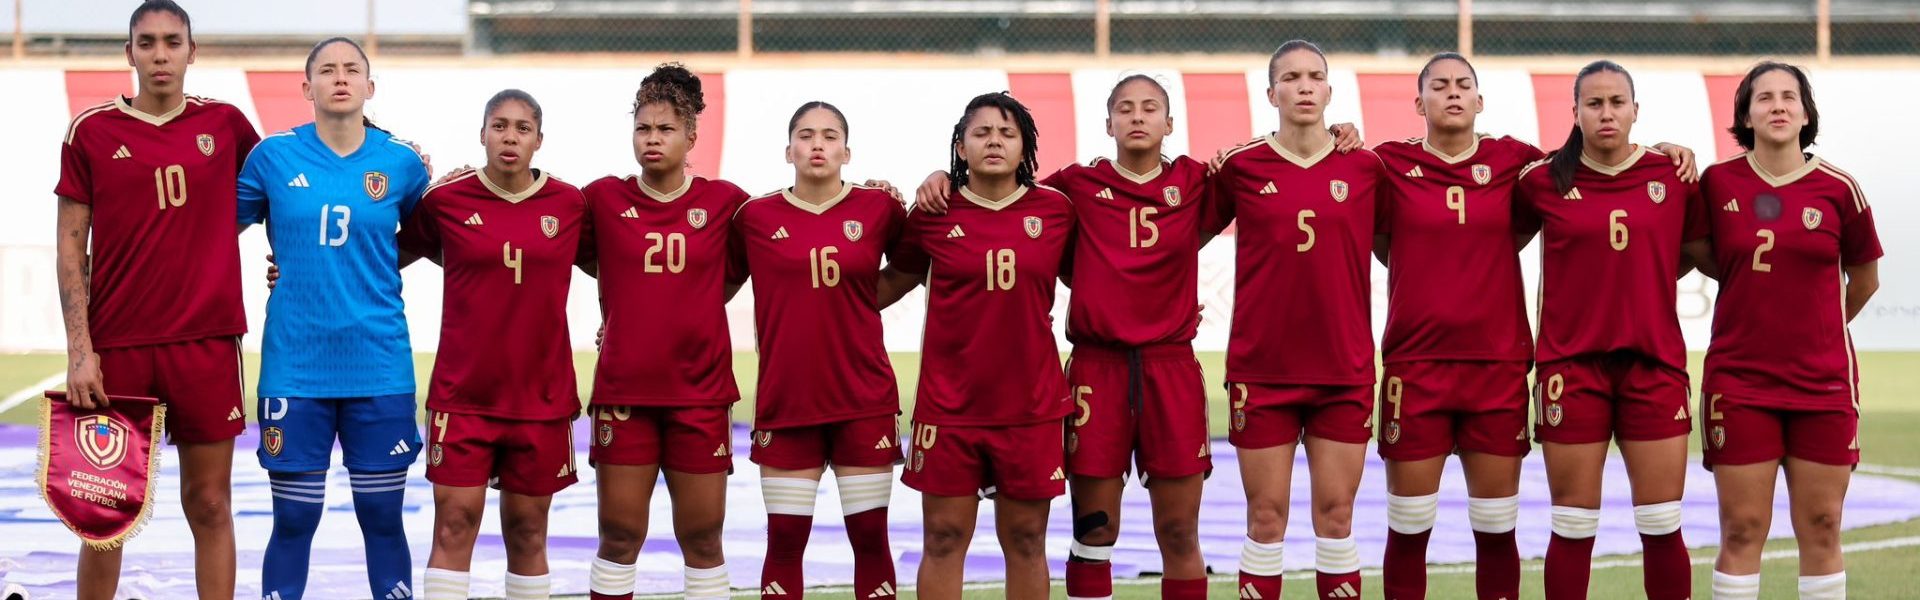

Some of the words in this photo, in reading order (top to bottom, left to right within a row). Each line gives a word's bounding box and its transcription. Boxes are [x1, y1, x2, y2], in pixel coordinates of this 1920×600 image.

[155, 164, 187, 210] 10
[1446, 185, 1466, 225] 9
[319, 203, 352, 247] 13
[1129, 206, 1160, 248] 15
[1296, 209, 1316, 252] 5
[1609, 209, 1629, 251] 6
[503, 241, 523, 284] 4
[644, 232, 686, 274] 20
[809, 246, 841, 289] 16
[986, 248, 1016, 291] 18
[1752, 228, 1775, 273] 2
[1072, 385, 1093, 427] 5
[1387, 376, 1403, 420] 9
[67, 478, 127, 500] VENEZOLANA
[70, 488, 84, 498] DE
[84, 491, 118, 508] FÚTBOL
[71, 470, 127, 491] FEDERACIÓN
